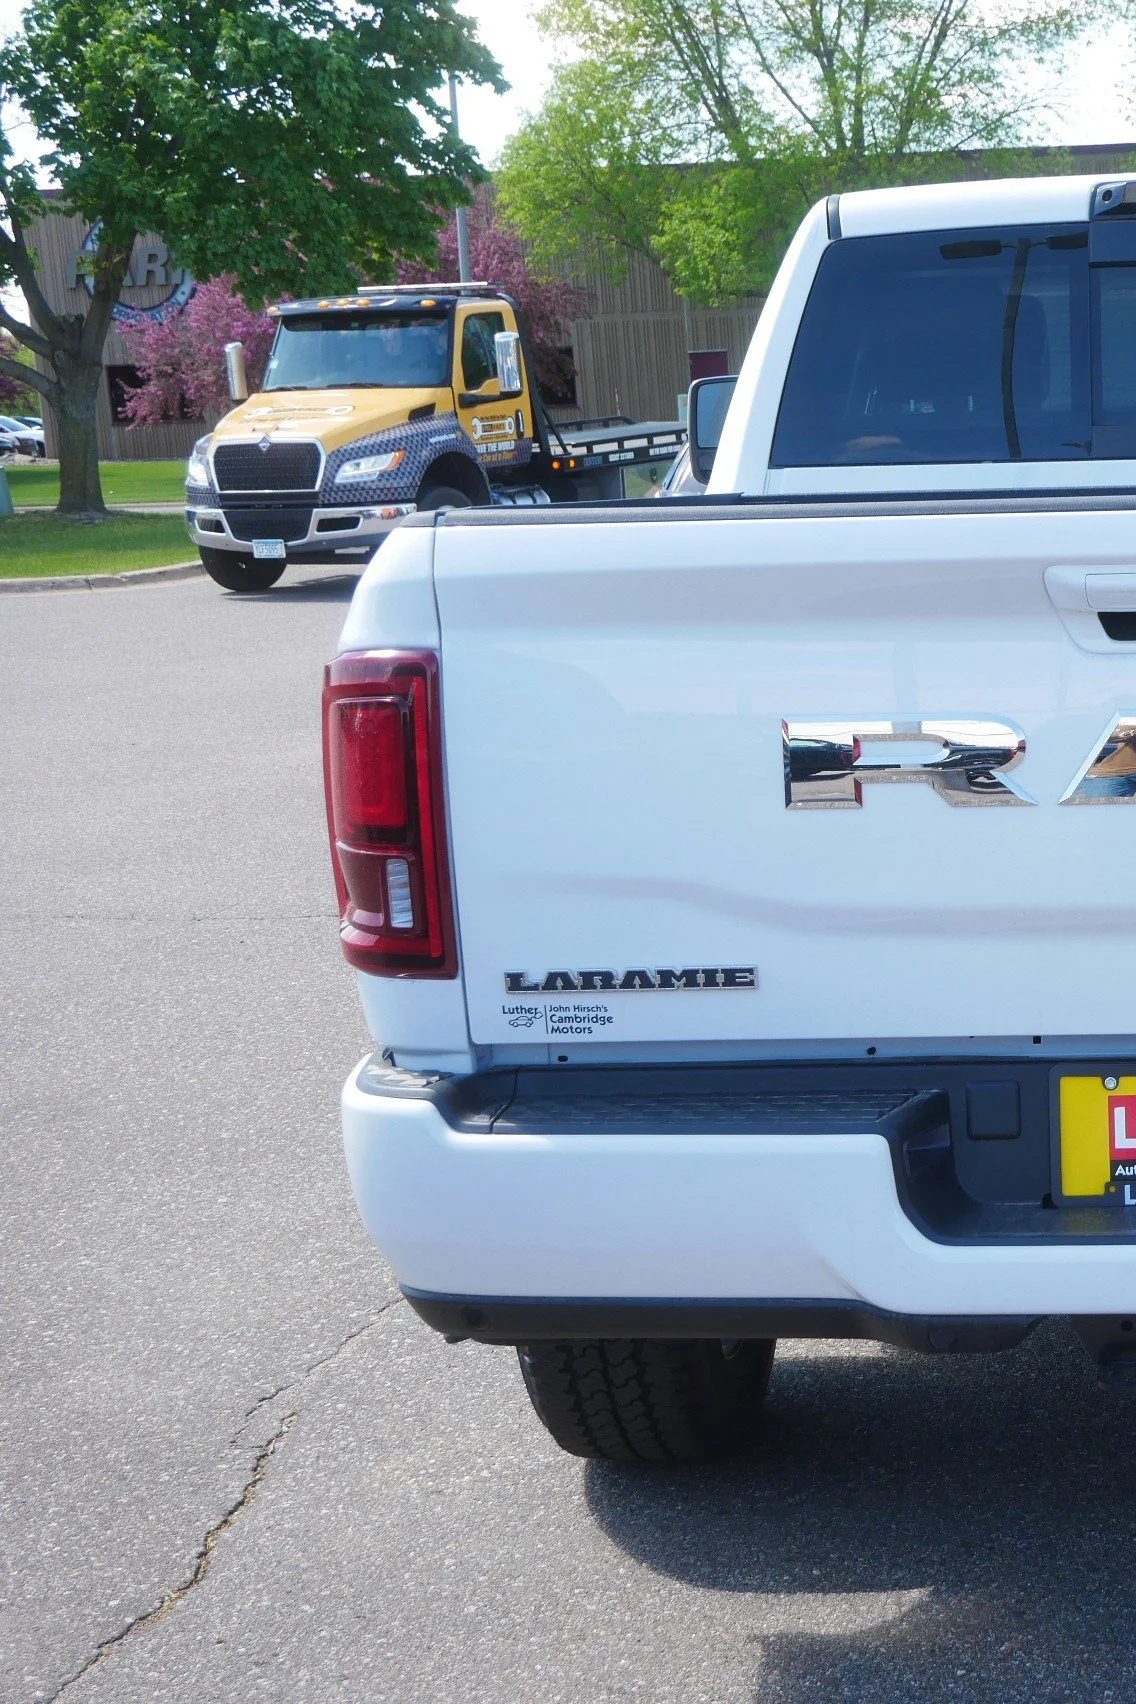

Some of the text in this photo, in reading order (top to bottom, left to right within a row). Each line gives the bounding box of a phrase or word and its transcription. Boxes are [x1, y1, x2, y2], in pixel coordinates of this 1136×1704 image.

[504, 965, 760, 994] LARAMIE
[502, 1004, 541, 1016] Luther
[549, 1004, 609, 1013] John Hirsch's
[549, 1013, 614, 1026] Cambridge
[550, 1025, 594, 1035] Motors
